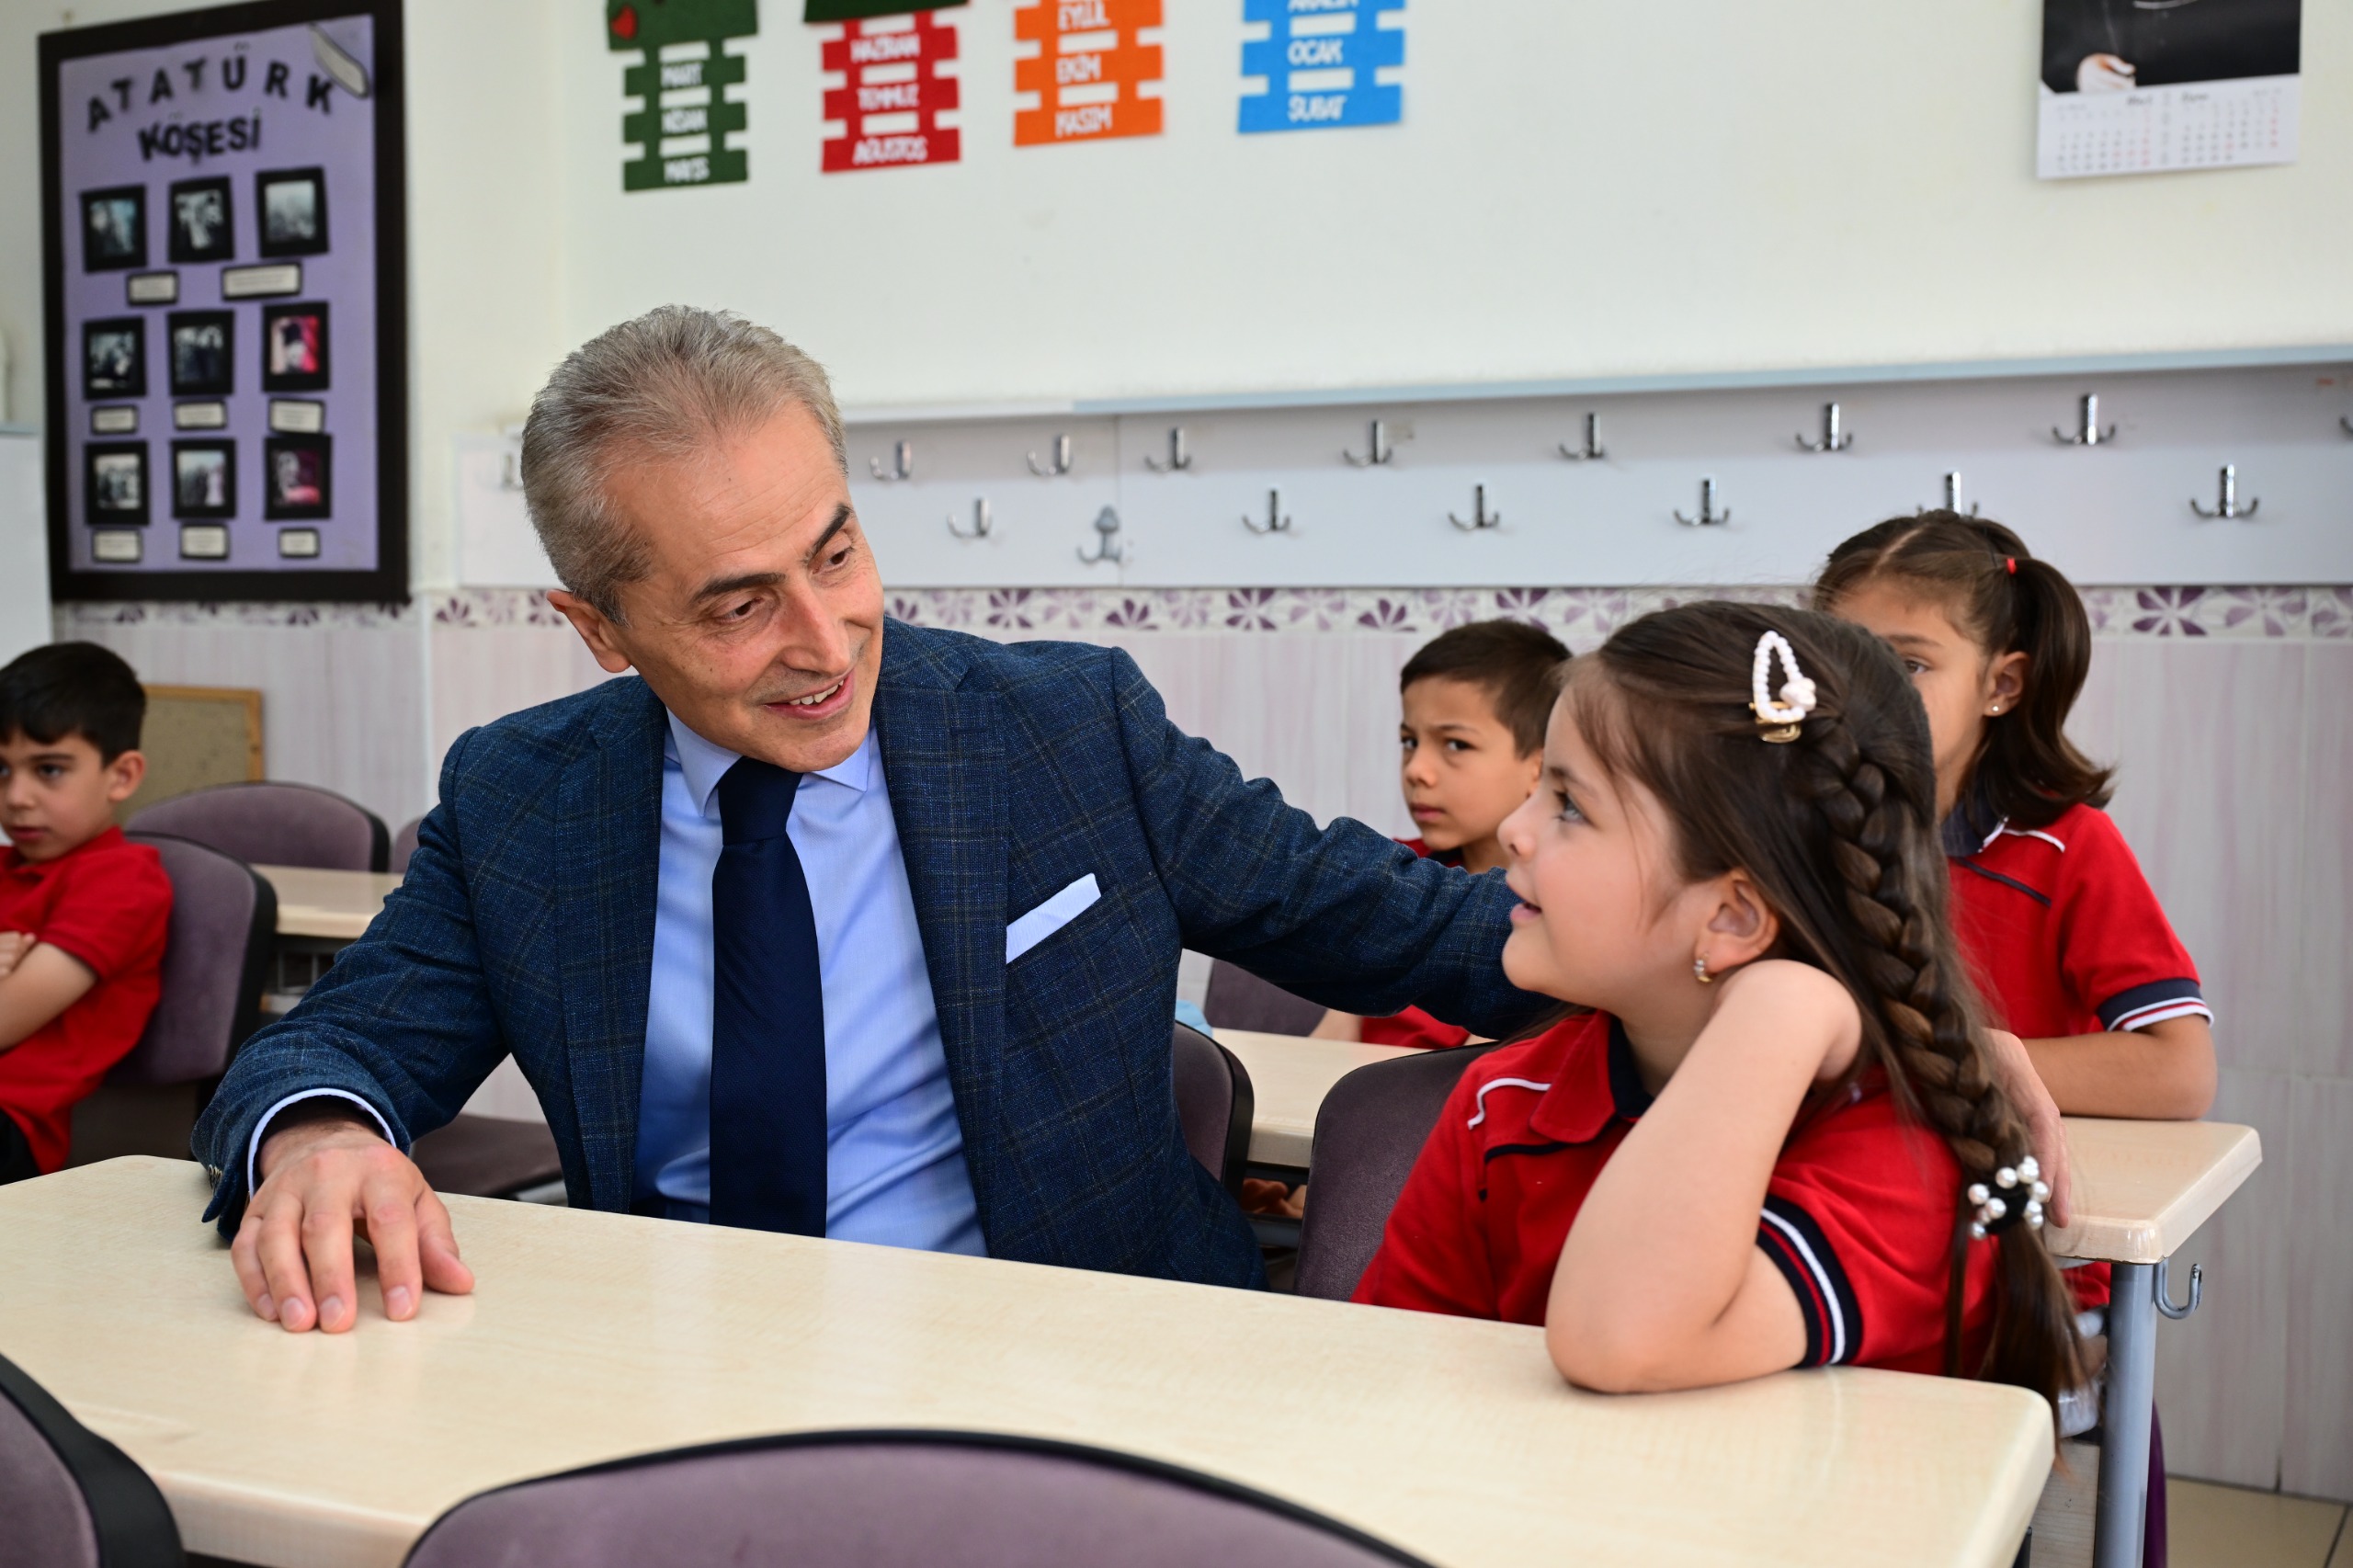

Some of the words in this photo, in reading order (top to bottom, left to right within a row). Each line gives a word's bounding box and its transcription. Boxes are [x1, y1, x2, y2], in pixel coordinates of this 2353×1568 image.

[1287, 38, 1344, 66] OCAK
[86, 41, 334, 134] ATATÜRK
[137, 108, 263, 166] KÖŞESİ
